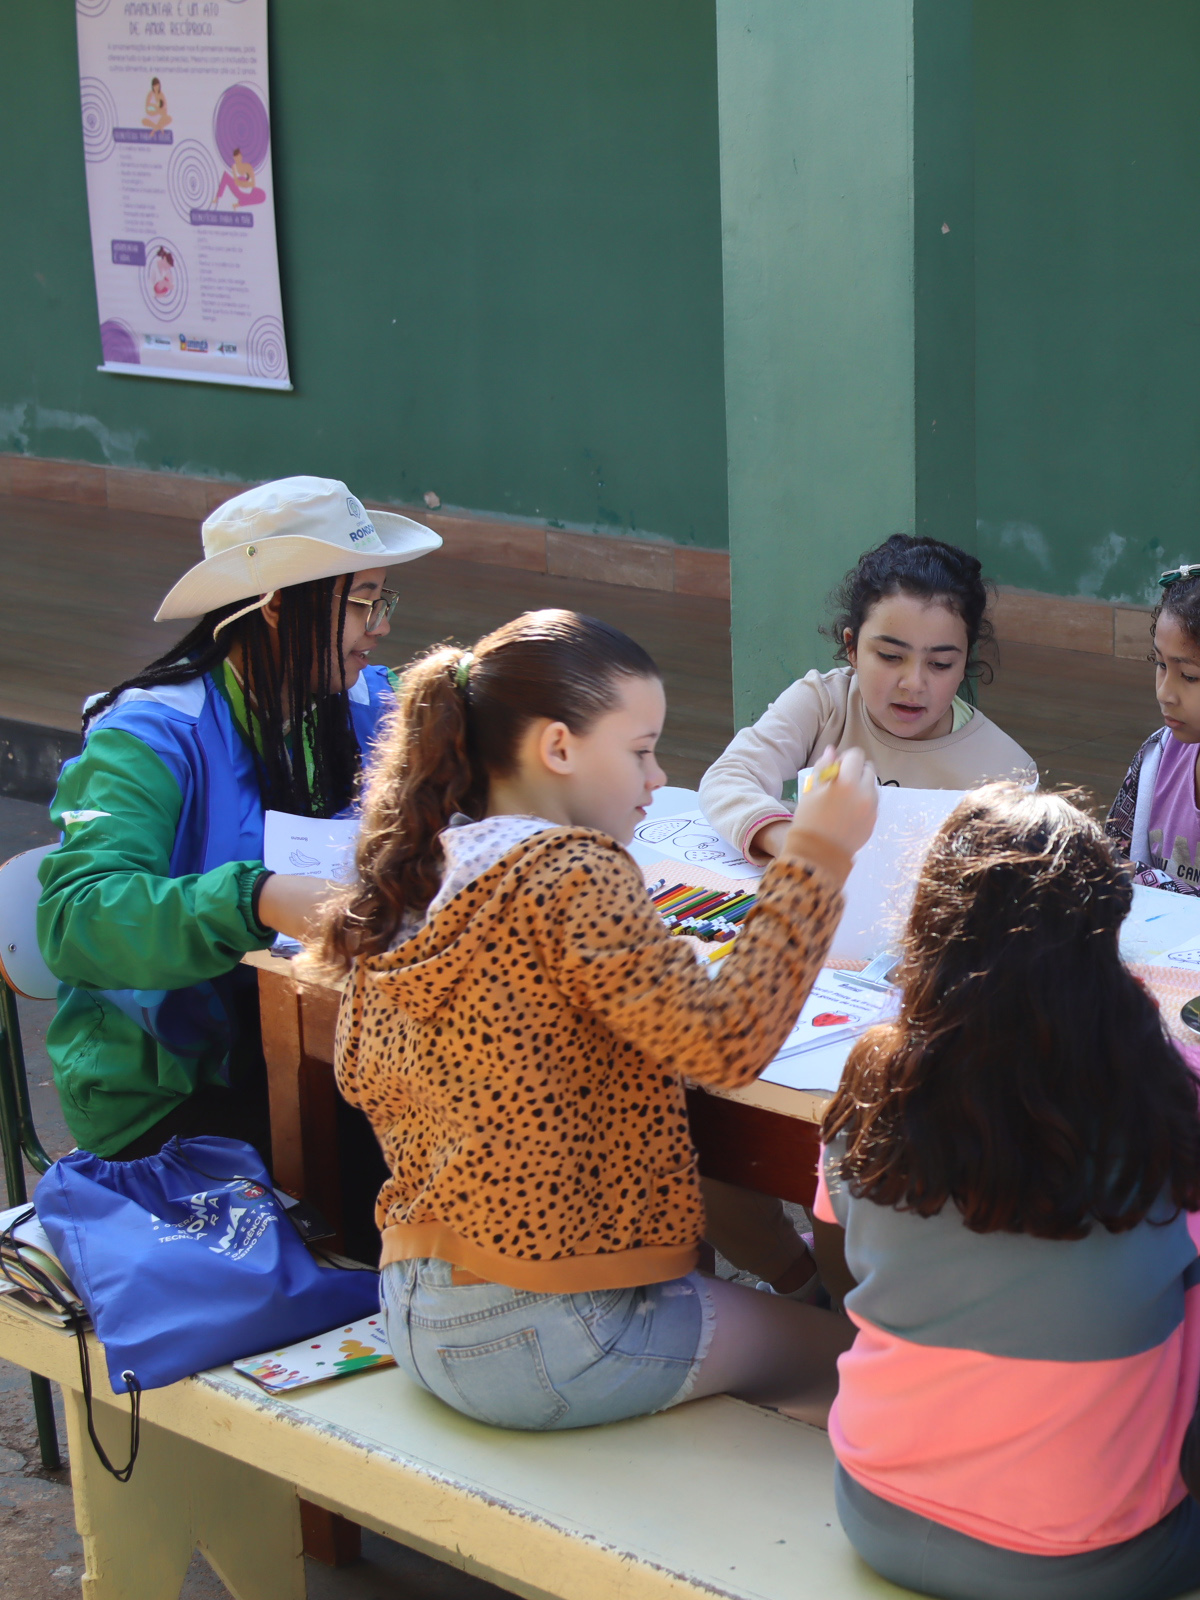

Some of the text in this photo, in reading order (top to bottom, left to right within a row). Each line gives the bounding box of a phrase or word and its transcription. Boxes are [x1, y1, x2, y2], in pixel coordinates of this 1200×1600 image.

[124, 2, 172, 16] AMAMENTAR
[203, 3, 219, 17] ATO
[129, 21, 140, 35] DE
[145, 22, 165, 35] AMOR
